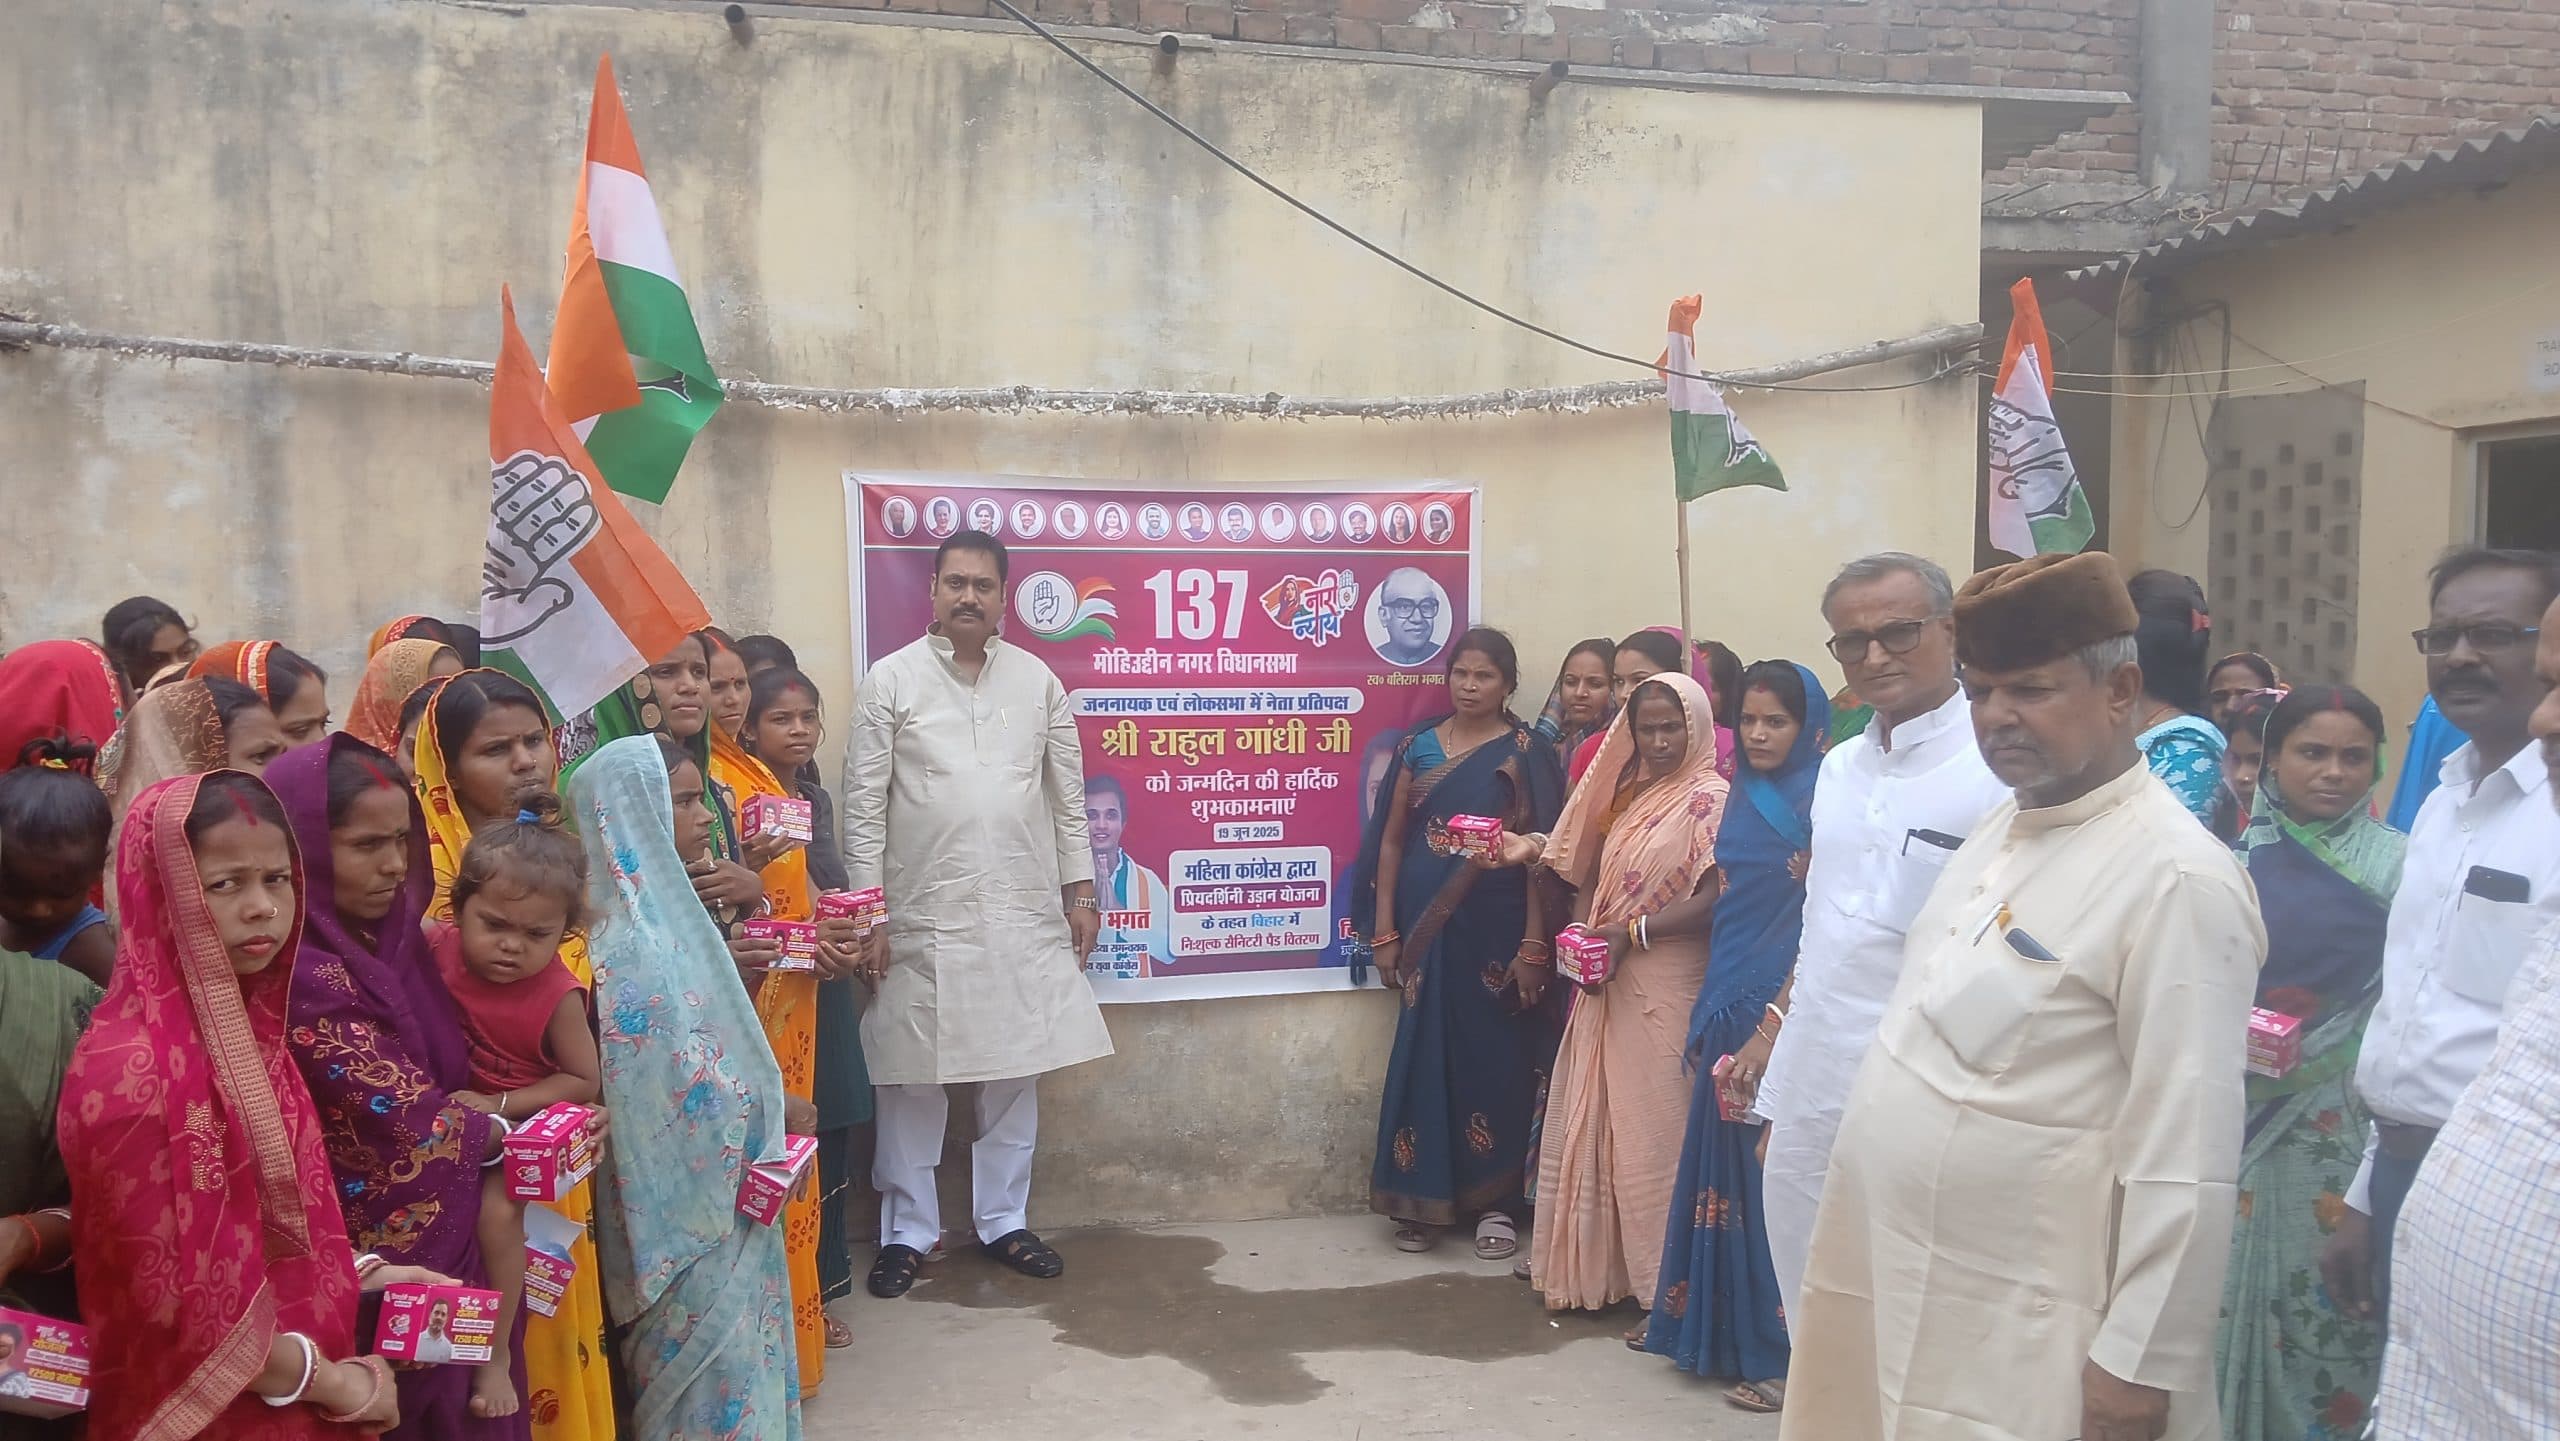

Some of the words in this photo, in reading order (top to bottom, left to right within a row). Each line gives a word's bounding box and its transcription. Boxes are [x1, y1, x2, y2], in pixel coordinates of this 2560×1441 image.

[1144, 568, 1248, 640] 137
[1304, 571, 1341, 618] नारी
[1294, 611, 1341, 644] न्याय
[1093, 647, 1173, 675] मोहिउद्दीन
[1177, 653, 1214, 675] नगर
[1217, 648, 1298, 674] विधानसभा
[1422, 674, 1445, 685] भगत
[1082, 697, 1153, 713] जननायक
[1156, 692, 1179, 712] एवं
[1183, 692, 1245, 712] लोकसभा
[1249, 692, 1264, 711] में
[1267, 692, 1293, 711] नेता
[1297, 692, 1349, 711] प्रतिपक्ष
[1101, 719, 1139, 757] श्री
[1149, 728, 1226, 766] राहुल
[1235, 718, 1308, 755] गांधी
[1316, 717, 1352, 754] जी
[1145, 769, 1171, 793] को
[1176, 768, 1249, 792] जन्मदिन
[1255, 769, 1280, 791] की
[1285, 767, 1339, 792] हार्दिक
[1190, 794, 1297, 822] शुभकामनाएं
[1217, 828, 1229, 839] 19
[1232, 827, 1250, 841] जून
[1253, 826, 1280, 838] 2025
[1184, 859, 1231, 881] महिला
[1235, 857, 1282, 880] कांग्रेस
[1286, 860, 1317, 880] द्वारा
[1180, 886, 1243, 907] प्रियदर्शिनी
[1280, 885, 1321, 903] योजना
[1107, 911, 1151, 930] भगत
[1200, 915, 1215, 930] के
[1218, 917, 1247, 929] तहत
[1251, 913, 1285, 927] बिहार
[1288, 912, 1301, 926] में
[1265, 932, 1281, 947] पैड
[1284, 932, 1321, 946] वितरण
